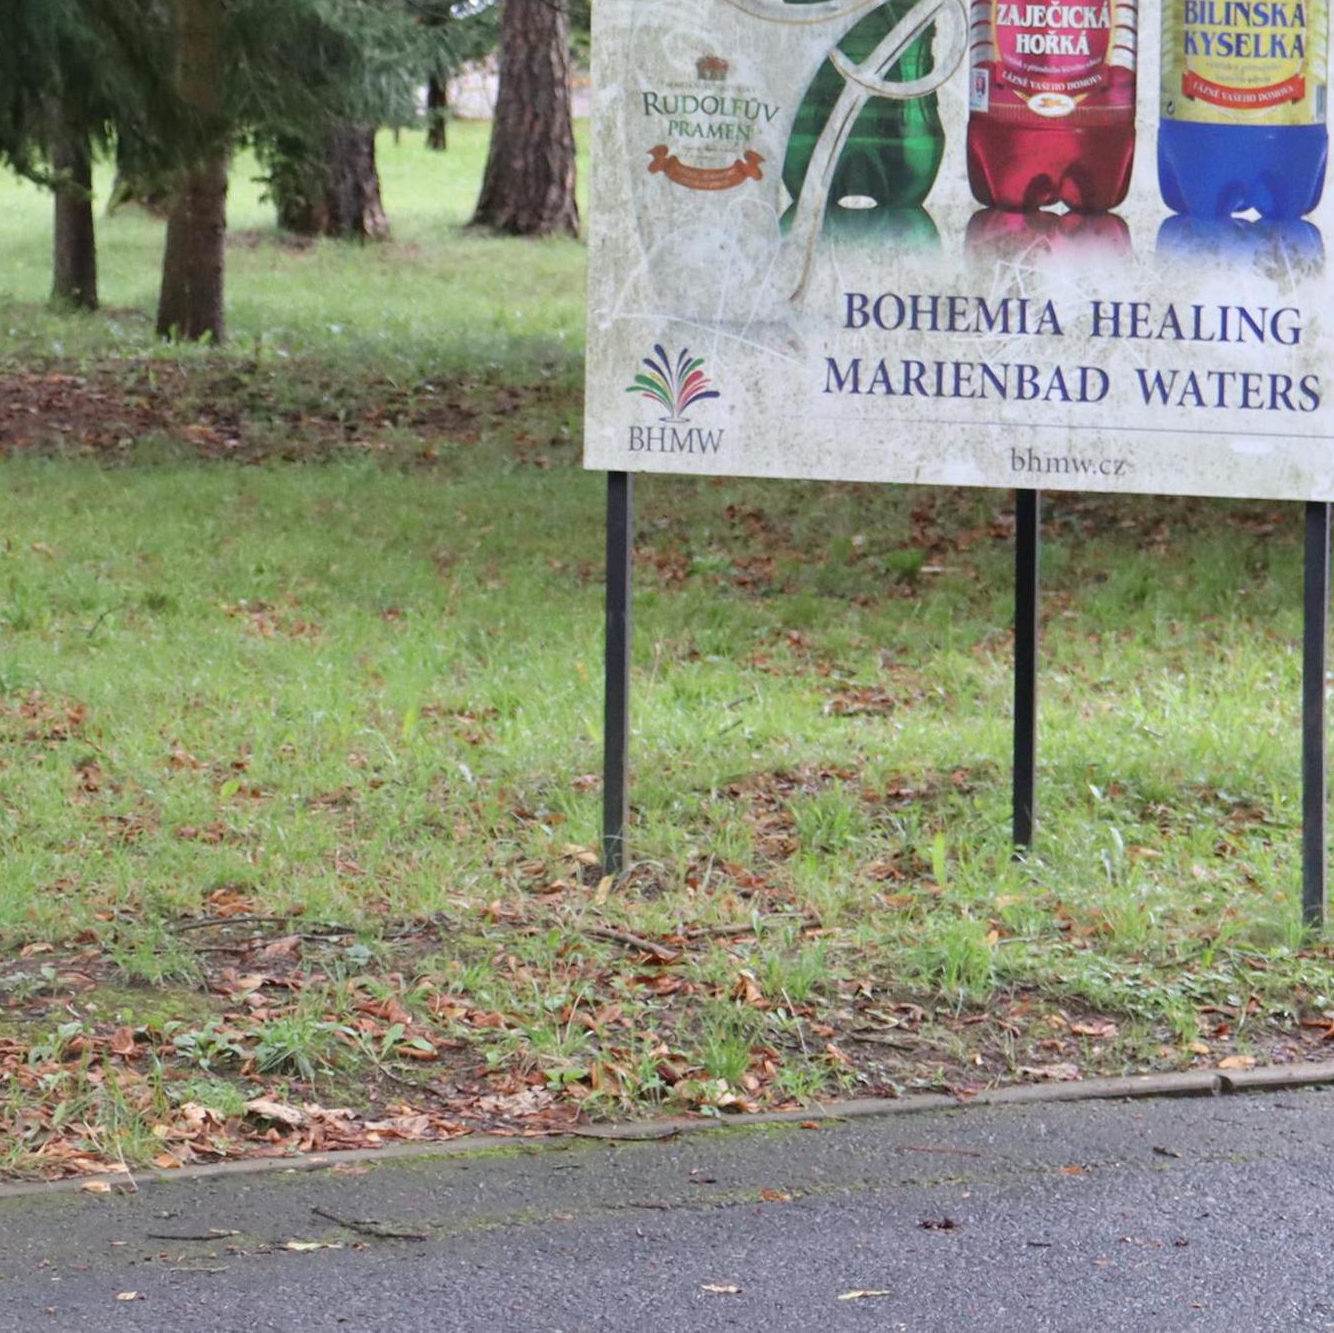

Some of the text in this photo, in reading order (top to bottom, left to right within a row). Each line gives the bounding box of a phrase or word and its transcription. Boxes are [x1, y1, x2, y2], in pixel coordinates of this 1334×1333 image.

[997, 0, 1111, 28] ZAJEČICKÁ
[1016, 30, 1090, 55] HOŘKÁ
[1184, 30, 1305, 58] KYSELKA
[643, 91, 781, 123] RUDOLFŮV
[668, 120, 752, 141] PRAMEN
[844, 292, 1302, 346] BOHEMIA HEALING
[822, 357, 1321, 413] MARIENBAD WATERS
[629, 425, 726, 454] BHMW
[1010, 447, 1127, 477] bhmw.cz
